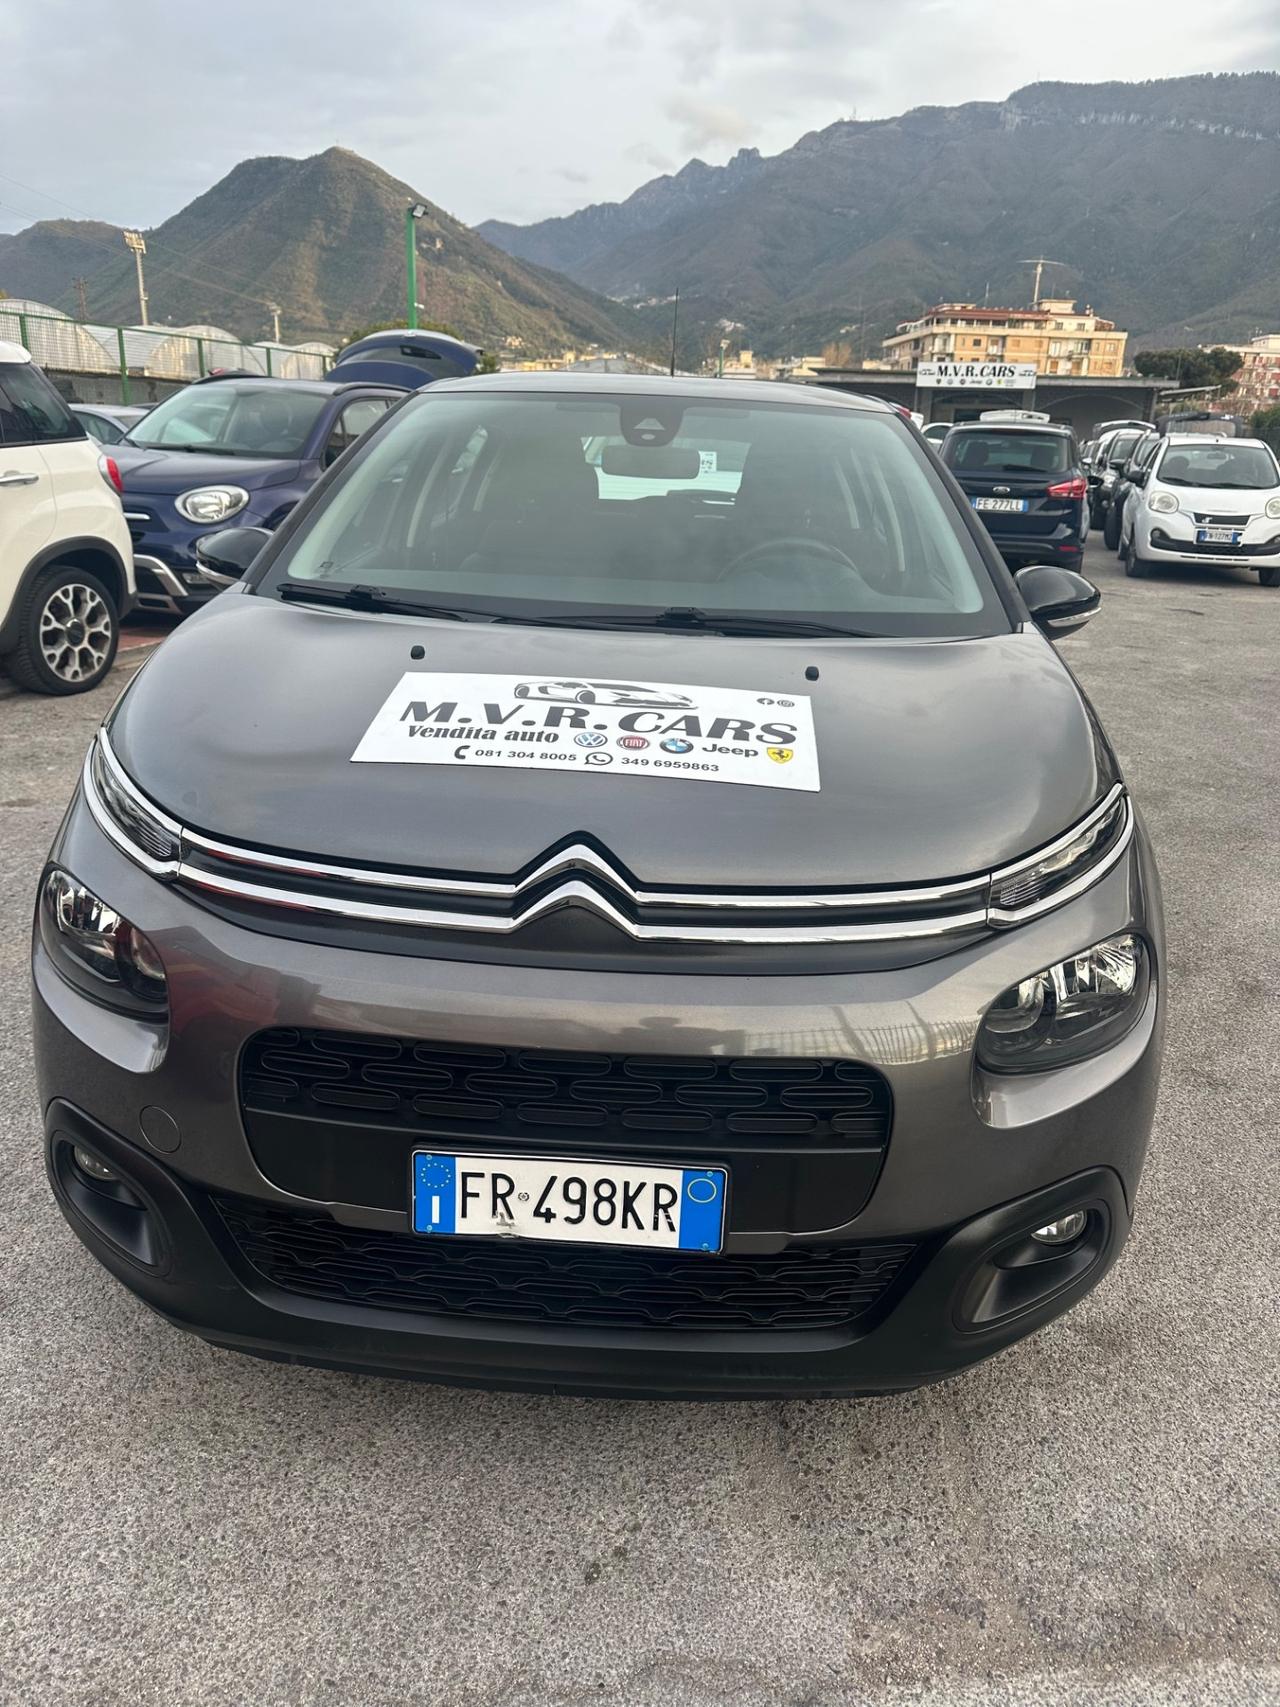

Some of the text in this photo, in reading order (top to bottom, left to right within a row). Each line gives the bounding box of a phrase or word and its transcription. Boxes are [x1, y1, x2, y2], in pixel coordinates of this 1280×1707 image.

[408, 725, 560, 743] Vendita auto
[624, 737, 645, 747] FIAT
[475, 749, 577, 762] 081 304 8005
[702, 743, 759, 758] Jeep
[621, 757, 720, 772] 349 6959863
